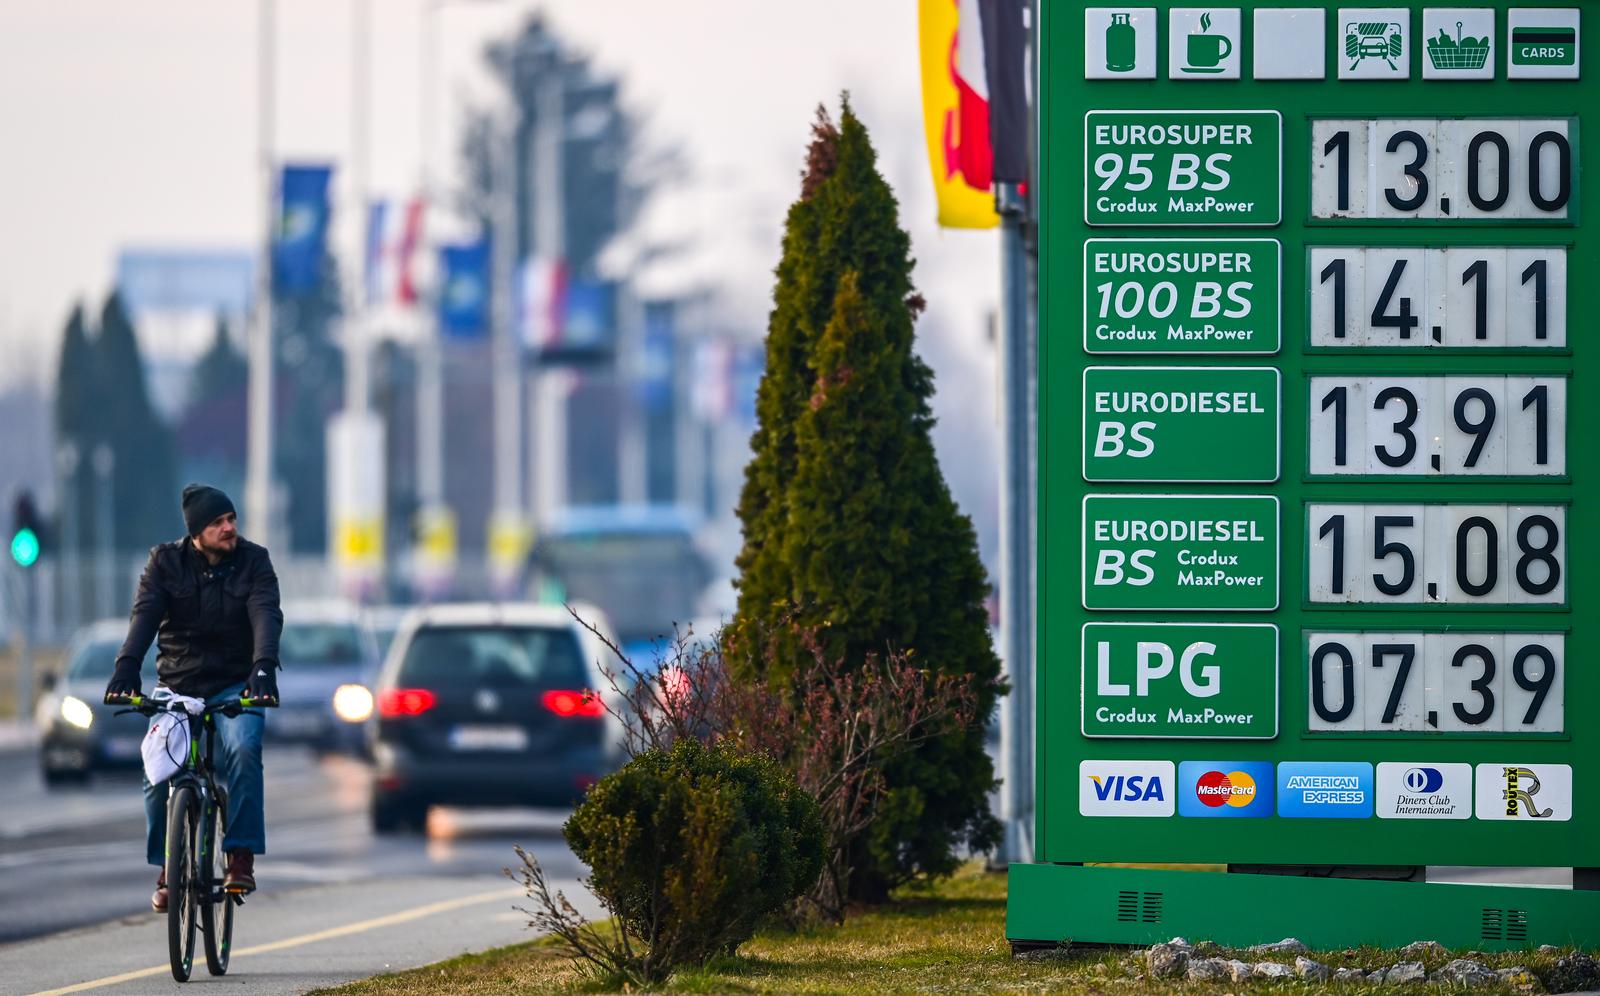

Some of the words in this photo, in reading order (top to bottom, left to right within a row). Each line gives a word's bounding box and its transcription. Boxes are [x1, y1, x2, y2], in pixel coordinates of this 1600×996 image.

[1521, 47, 1565, 58] CARDS
[1095, 124, 1253, 145] EUROSUPER
[1094, 152, 1155, 192] 95
[1167, 152, 1233, 192] BS
[1096, 196, 1158, 213] Crodux
[1167, 196, 1254, 213] MaxPower
[1095, 252, 1252, 273] EUROSUPER
[1097, 281, 1178, 319] 100
[1190, 281, 1254, 319] BS
[1095, 324, 1157, 340] Crodux
[1167, 324, 1254, 341] MaxPower
[1095, 391, 1265, 413] EURODIESEL
[1093, 420, 1157, 458] BS
[1094, 520, 1265, 542] EURODIESEL
[1177, 549, 1239, 565] Crodux
[1093, 549, 1157, 586] BS
[1177, 570, 1264, 587] MaxPower
[1097, 641, 1221, 698] LPG
[1095, 706, 1157, 723] Crodux
[1167, 707, 1253, 724] MaxPower
[1088, 775, 1165, 802] VISA
[1197, 784, 1256, 796] MasterCard
[1287, 775, 1359, 789] AMERICAN
[1506, 766, 1518, 816] ROUTEX
[1303, 790, 1364, 804] EXPRESS
[1396, 795, 1427, 806] Diners
[1428, 795, 1451, 806] Club
[1395, 805, 1455, 815] International
